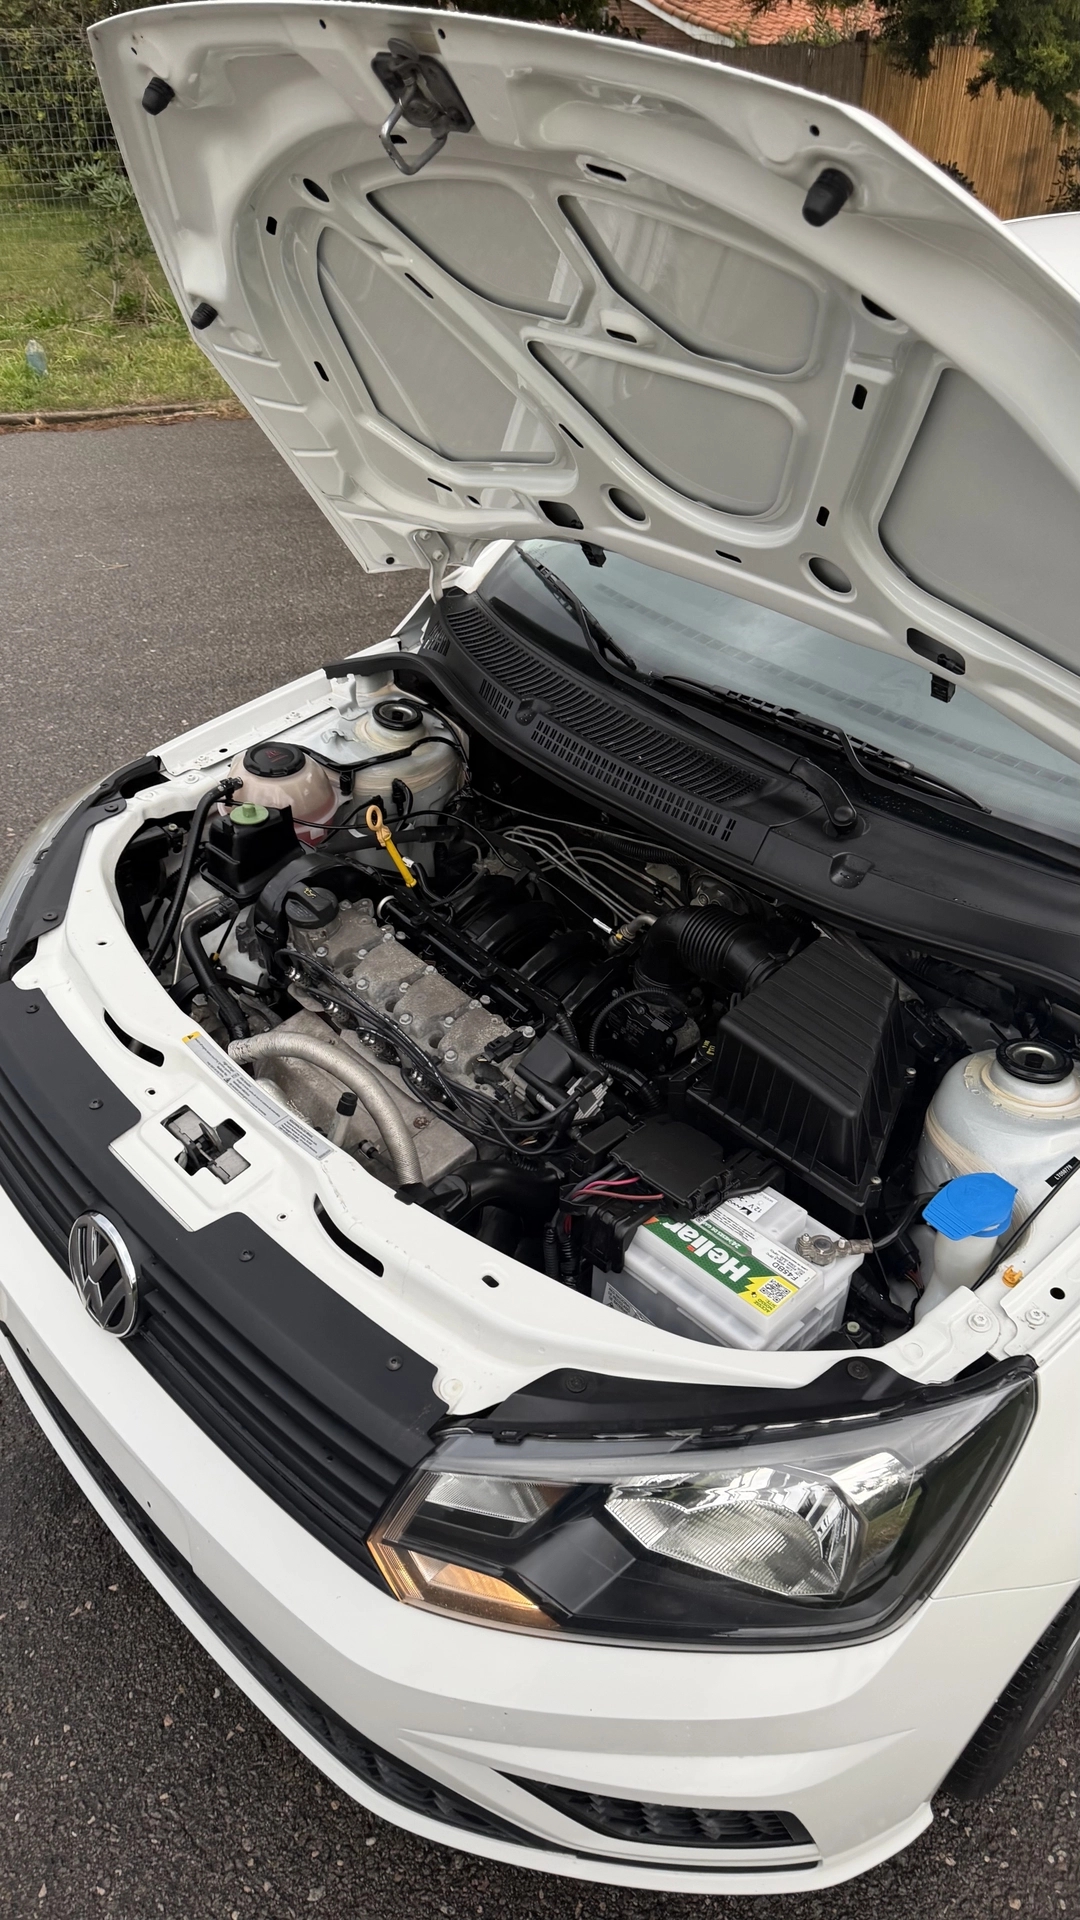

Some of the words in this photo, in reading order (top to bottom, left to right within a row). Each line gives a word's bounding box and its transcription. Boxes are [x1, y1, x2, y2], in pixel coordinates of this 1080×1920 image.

[662, 1222, 751, 1283] Heliar
[730, 1239, 741, 1249] 24
[771, 1261, 798, 1281] F45BD
